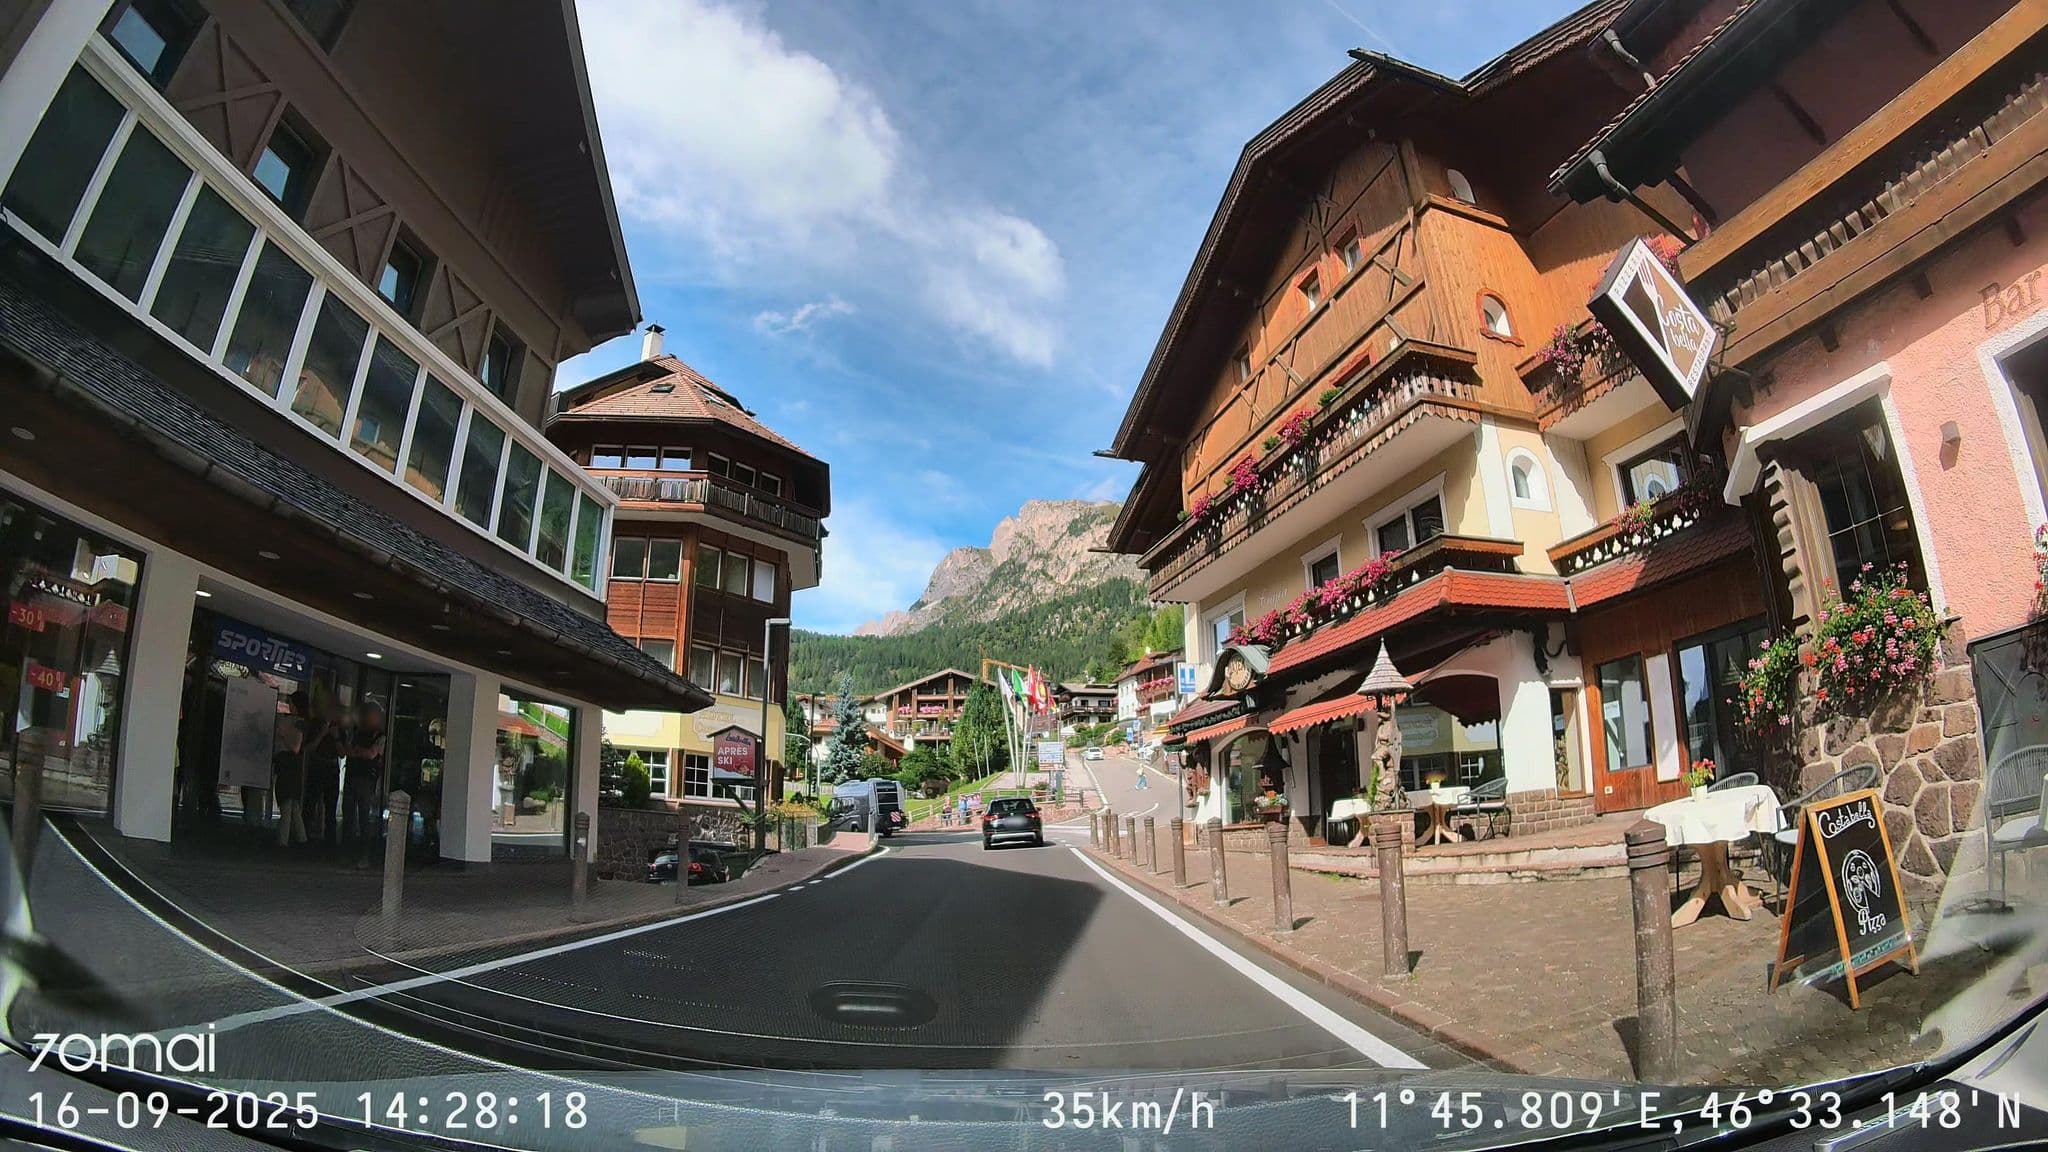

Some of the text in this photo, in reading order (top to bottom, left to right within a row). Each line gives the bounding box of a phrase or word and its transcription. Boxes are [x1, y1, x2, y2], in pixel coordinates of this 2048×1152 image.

[1656, 294, 1700, 336] Costa
[1979, 270, 2041, 330] Bar
[217, 629, 306, 673] SPORTLER
[717, 755, 733, 765] SKI
[1818, 801, 1876, 838] Costabella
[1858, 907, 1887, 936] Pizza
